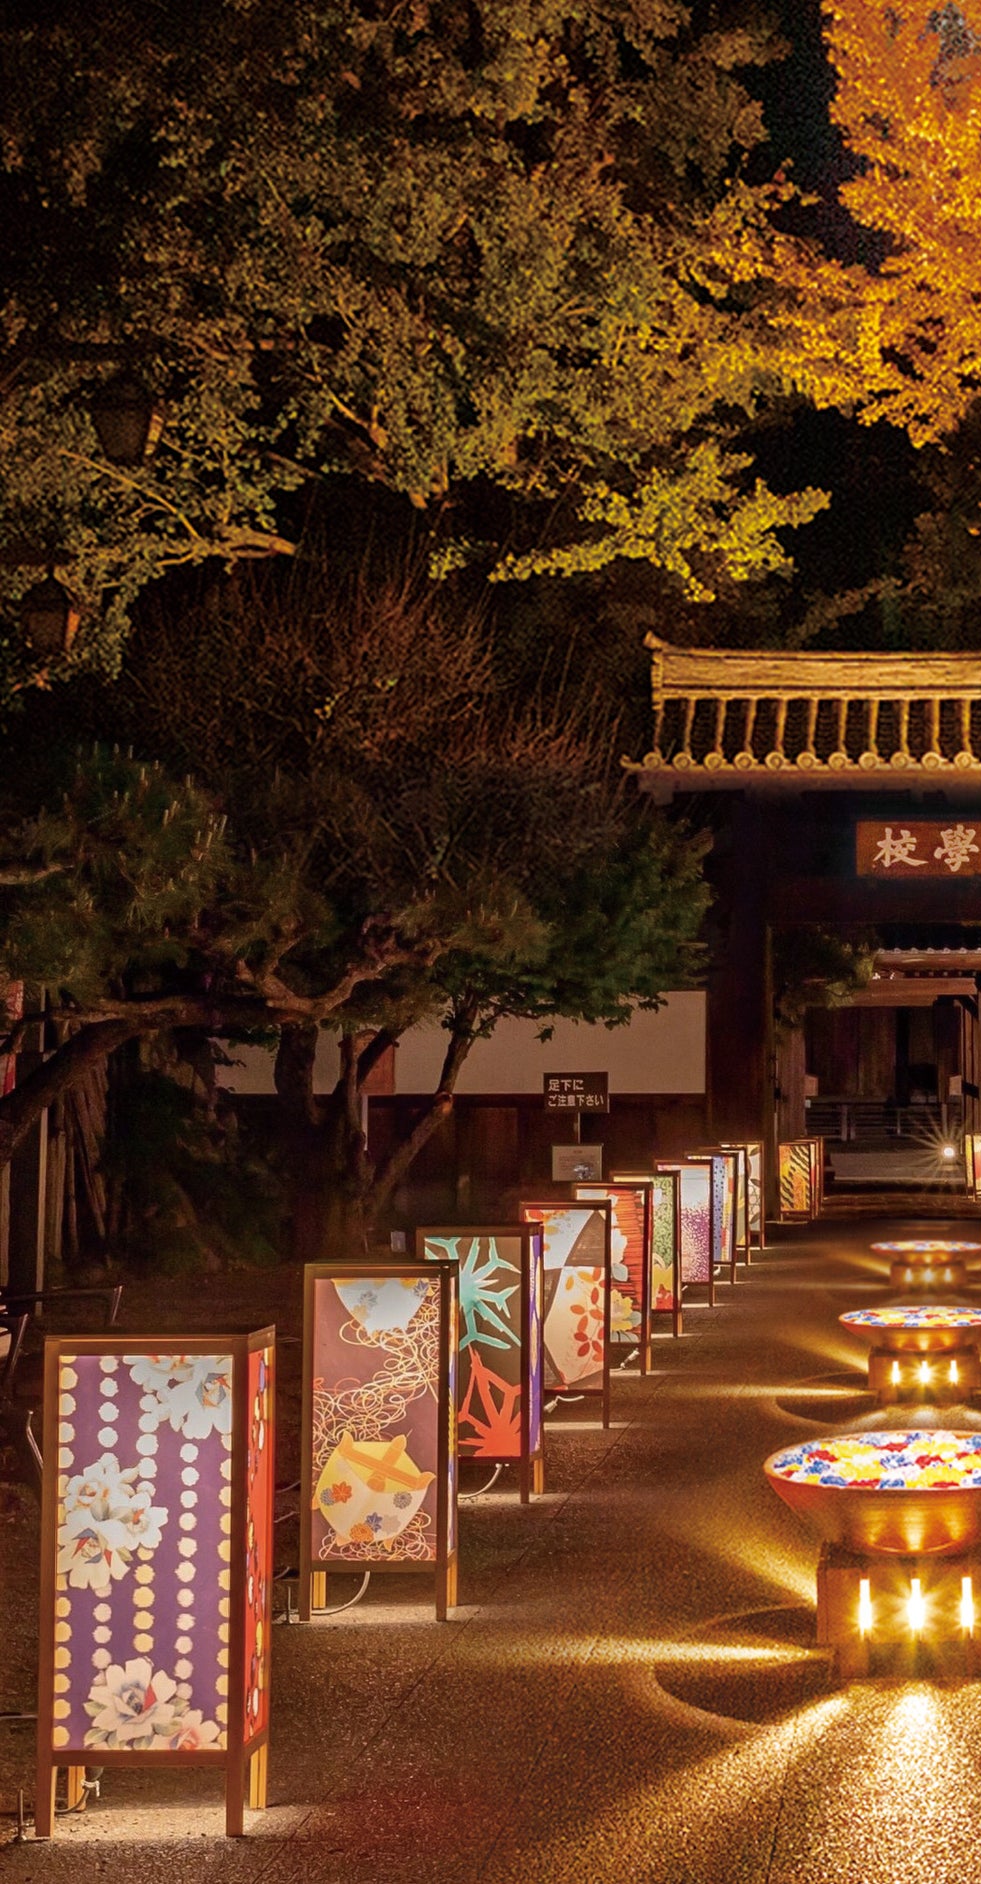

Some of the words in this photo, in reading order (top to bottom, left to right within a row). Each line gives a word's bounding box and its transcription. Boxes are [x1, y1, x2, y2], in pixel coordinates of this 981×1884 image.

[548, 1079, 584, 1091] 足下に
[548, 1094, 604, 1107] ご注意下さい
